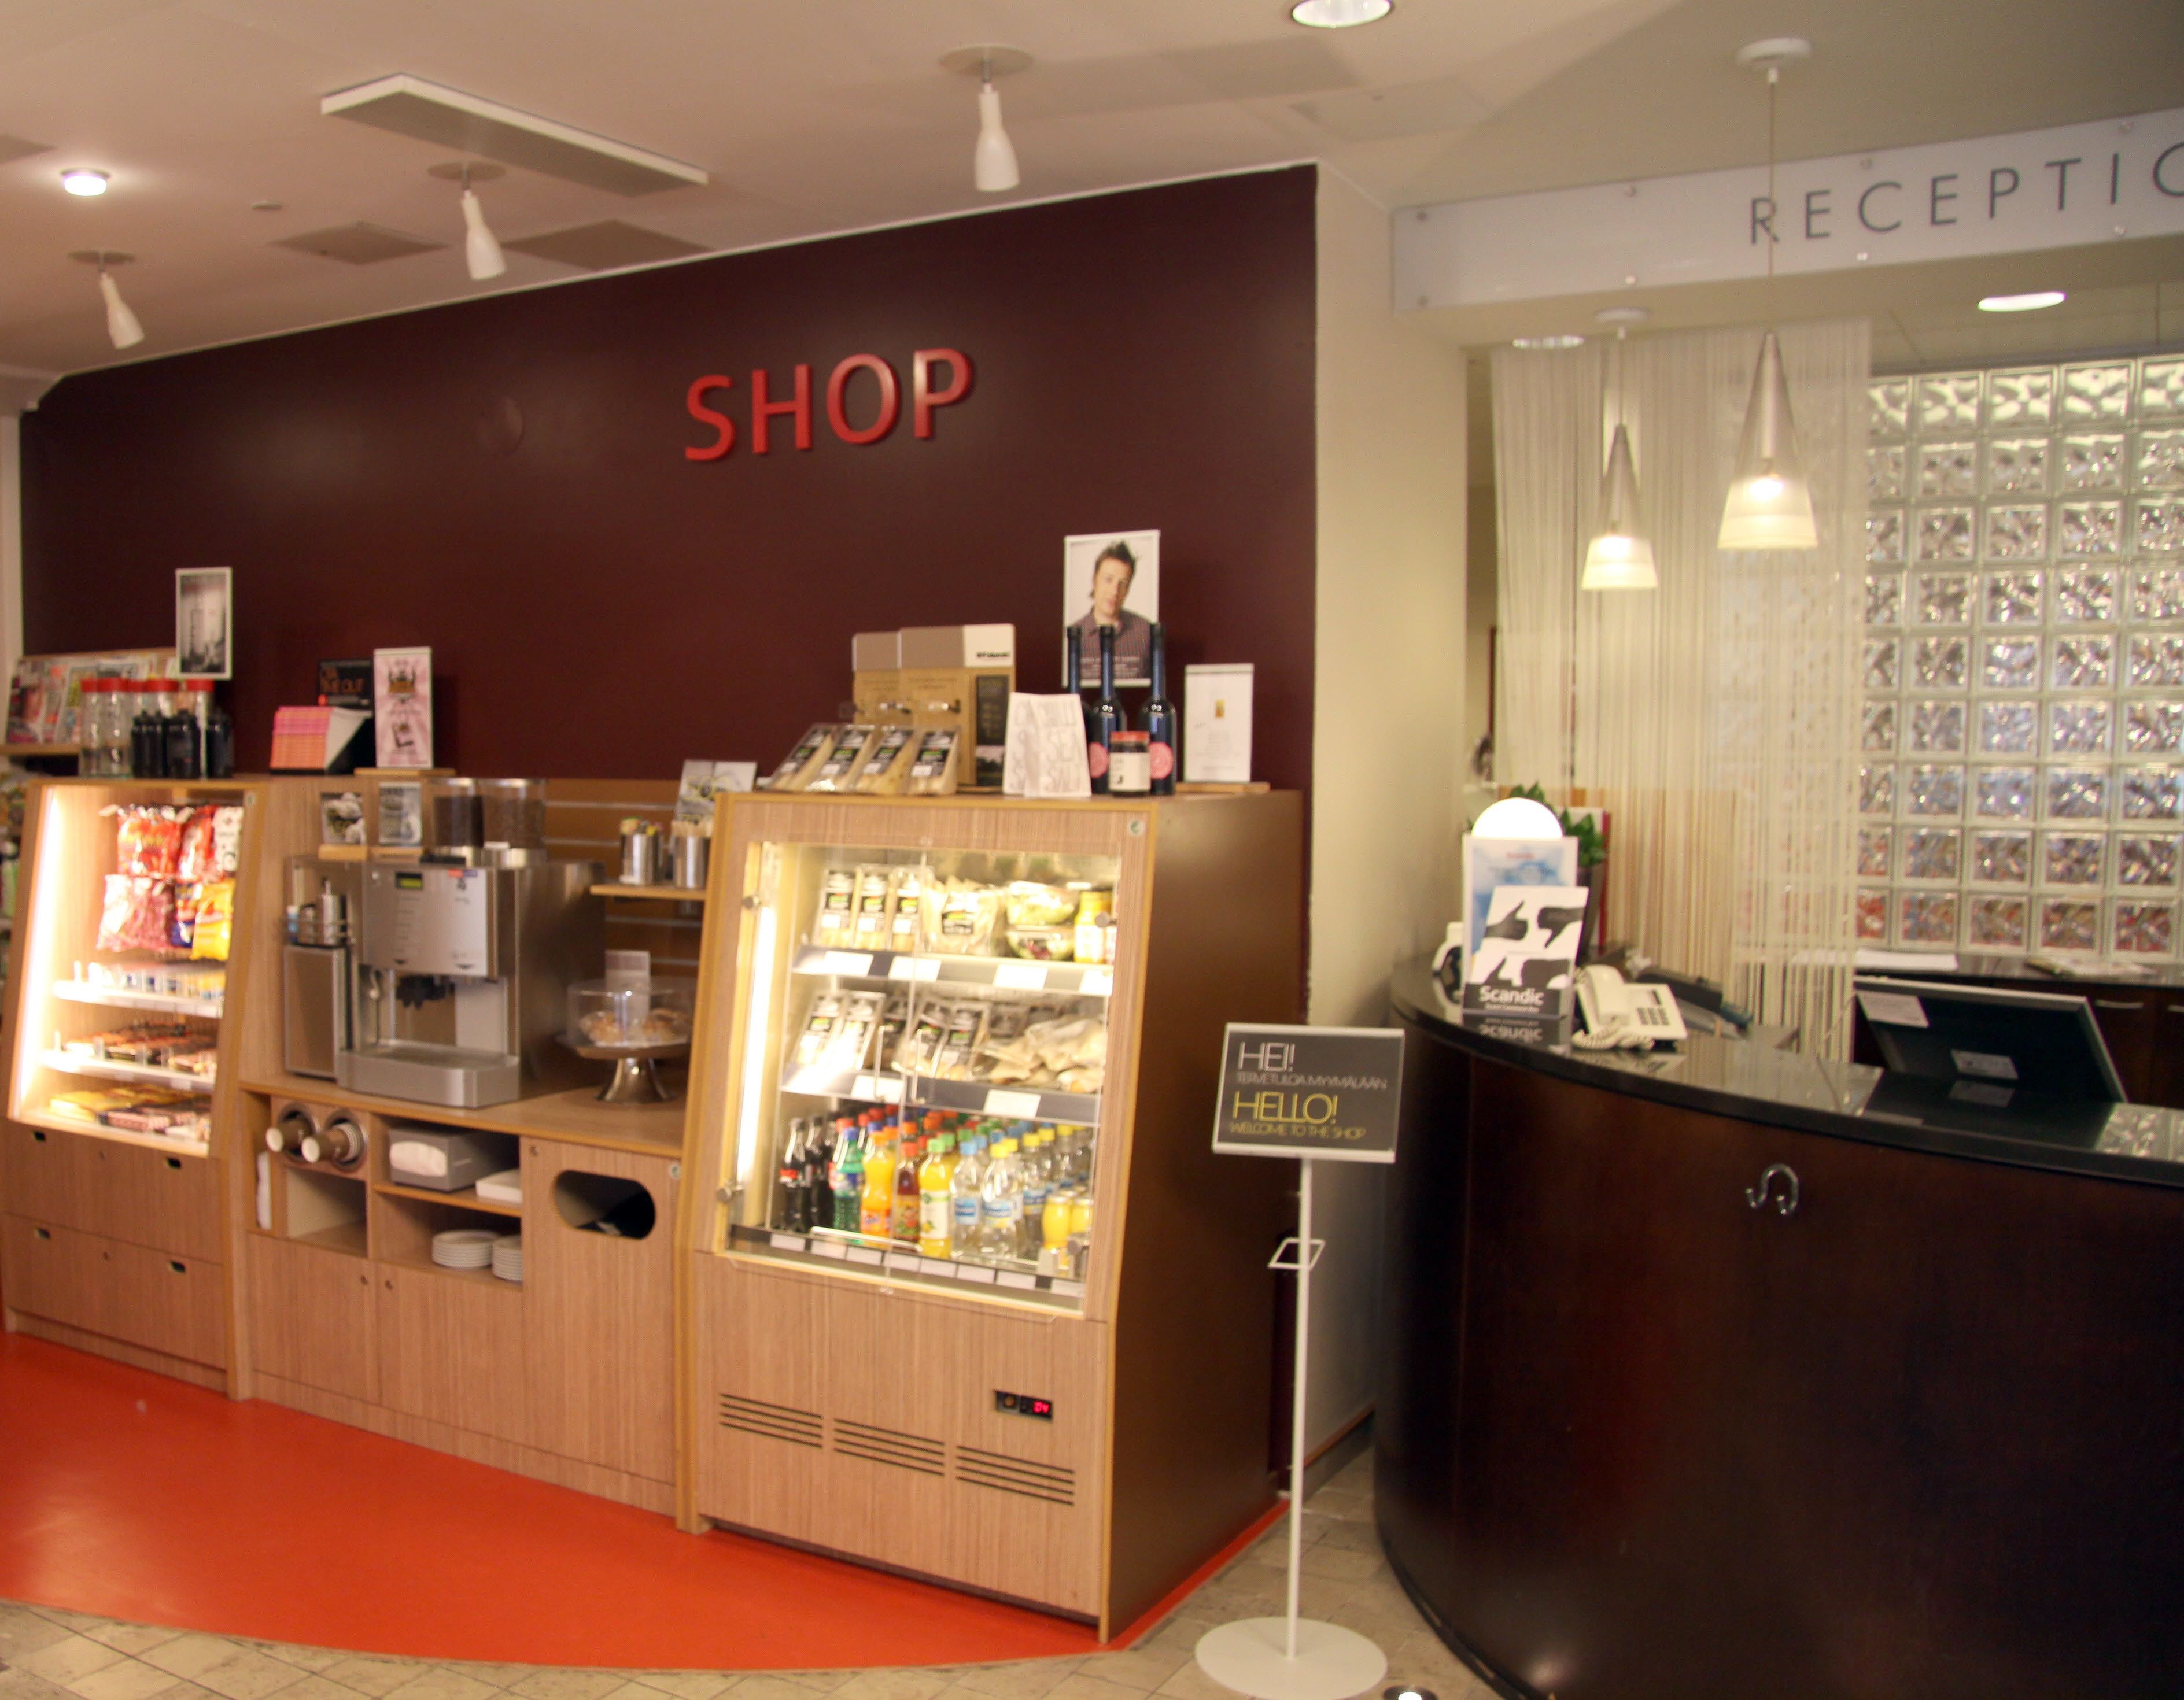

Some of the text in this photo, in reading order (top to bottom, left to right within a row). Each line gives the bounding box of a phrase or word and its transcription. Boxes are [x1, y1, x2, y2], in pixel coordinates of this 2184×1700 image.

[685, 348, 972, 461] SHOP
[1479, 985, 1545, 1006] Scandic
[1232, 1091, 1338, 1125] HELLO!
[1290, 1122, 1307, 1137] TO
[1331, 1124, 1367, 1140] SHOP
